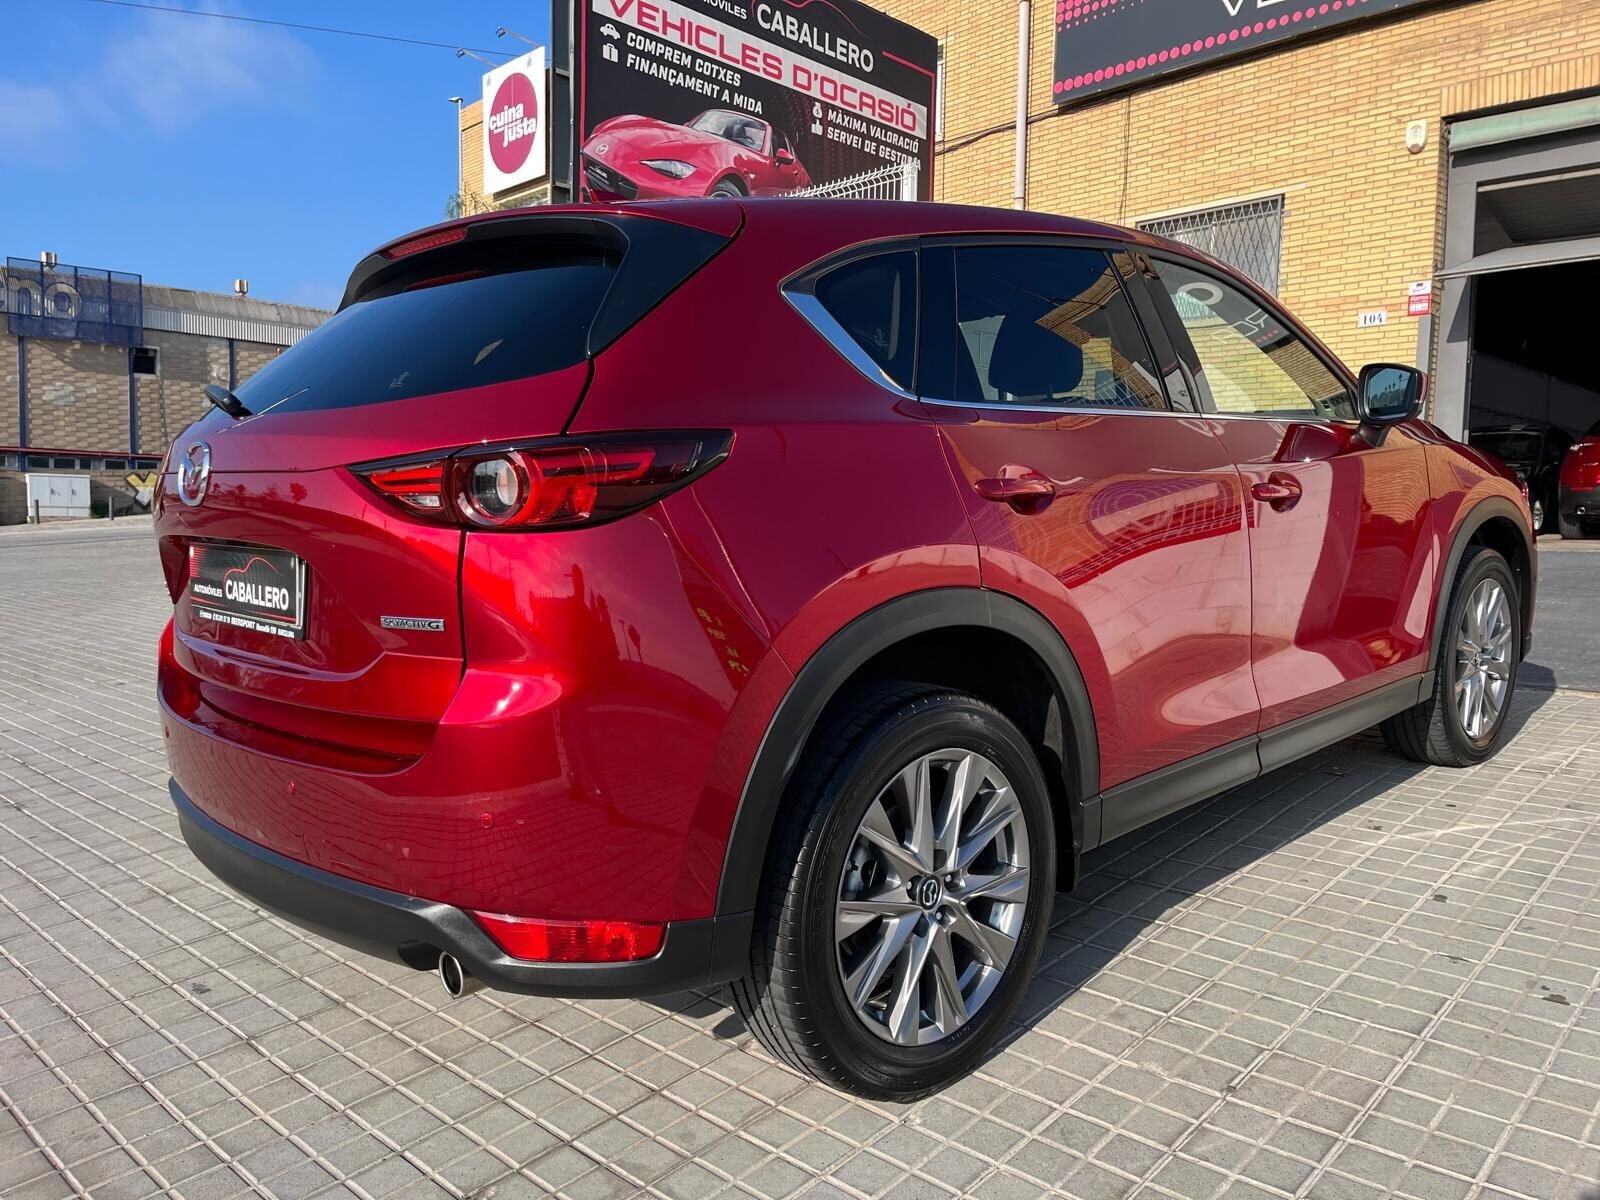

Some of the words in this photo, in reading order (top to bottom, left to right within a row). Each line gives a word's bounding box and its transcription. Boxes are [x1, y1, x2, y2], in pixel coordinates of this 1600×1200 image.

[757, 4, 874, 72] CABALLERO
[610, 0, 782, 80] VEHICLES
[792, 64, 917, 131] D'OCASIÓ
[626, 32, 692, 68] COMPREM
[695, 58, 741, 86] COTXES
[626, 53, 720, 98] FINANÇAMENT
[721, 89, 730, 103] A
[733, 92, 762, 114] MIDA
[489, 103, 524, 130] cuina
[502, 117, 536, 147] justa
[828, 109, 867, 134] MÀXIMA
[870, 124, 919, 153] VALORACIÓ
[827, 126, 861, 149] SERVEI
[864, 139, 877, 155] DE
[1363, 313, 1383, 325] 104
[225, 579, 289, 611] CABALLERO
